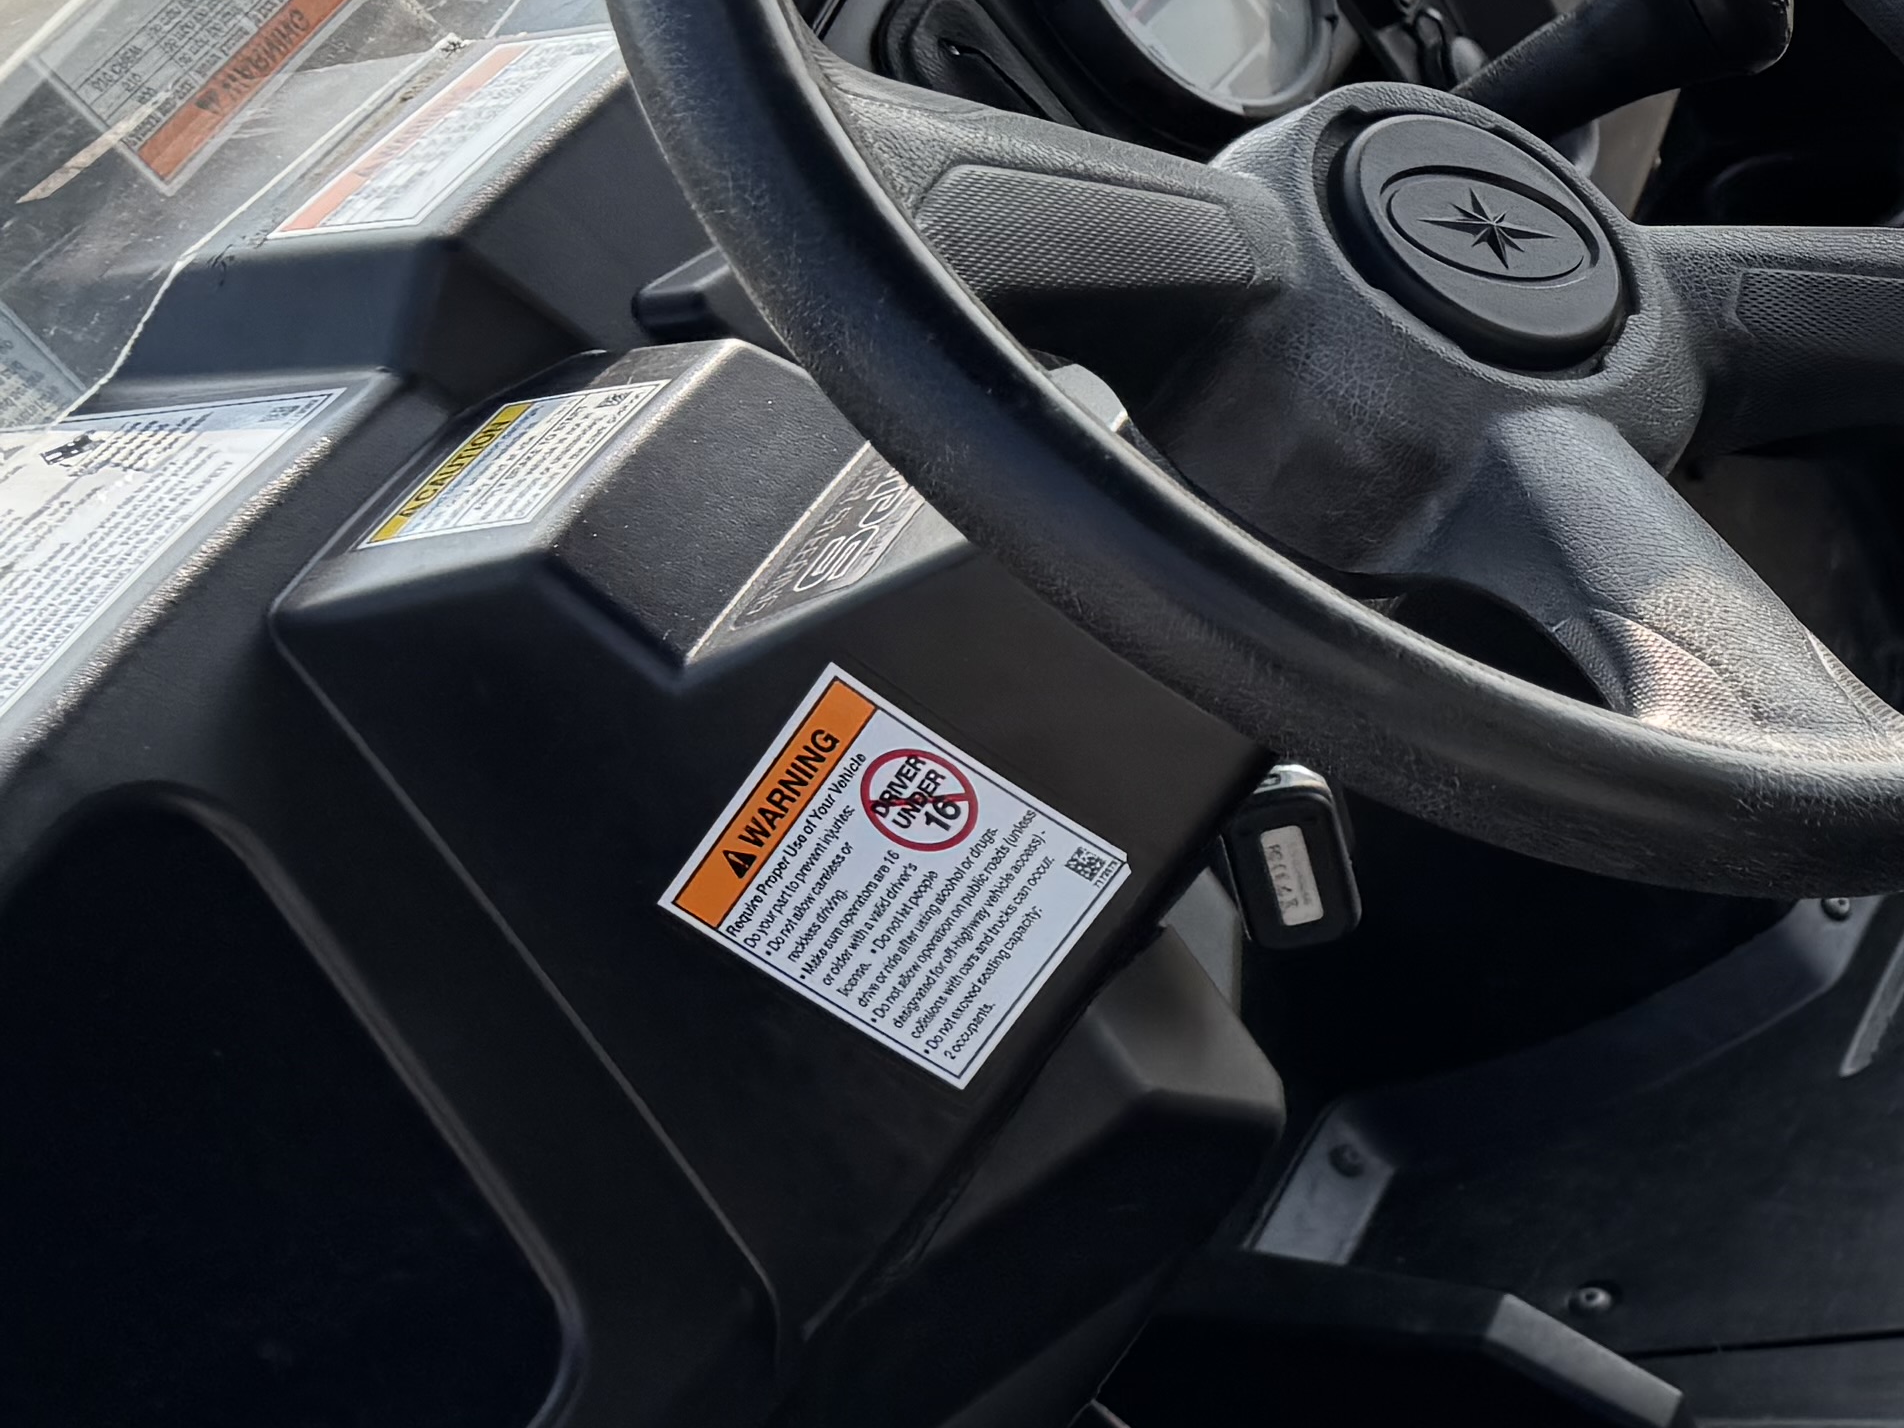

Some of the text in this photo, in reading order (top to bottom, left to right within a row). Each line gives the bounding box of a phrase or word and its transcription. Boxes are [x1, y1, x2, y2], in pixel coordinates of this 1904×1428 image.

[409, 419, 512, 502] CAUTION
[793, 468, 909, 592] PS
[736, 728, 840, 848] WARNING
[869, 753, 928, 820] DRIVER
[890, 768, 948, 832] UNDER
[924, 795, 963, 834] 16
[724, 753, 866, 937] Require Proper Use of Your Vehicle
[742, 804, 855, 949] Do your part to prevent injuries:
[872, 864, 890, 882] are
[882, 849, 899, 864] 16
[765, 840, 853, 952] Do not allow careless or
[871, 933, 891, 950] Do
[884, 915, 904, 935] not
[907, 870, 938, 907] people
[871, 1002, 891, 1019] Do
[884, 985, 904, 1005] not
[916, 915, 956, 963] operation
[950, 903, 967, 918] on
[959, 872, 989, 907] public
[982, 844, 1010, 875] roads
[874, 970, 888, 984] or
[896, 929, 919, 955] after
[960, 855, 974, 870] or
[968, 827, 998, 858] drugs.
[928, 960, 947, 978] for
[983, 872, 1015, 907] vehicle
[942, 974, 964, 996] with
[958, 952, 980, 976] cars
[974, 931, 995, 955] and
[986, 903, 1017, 936] trucks
[1012, 884, 1032, 905] can
[821, 972, 835, 986] or
[847, 928, 869, 950] with
[924, 1034, 944, 1050] Do
[937, 1017, 956, 1036] not
[943, 1049, 956, 1060] 2
